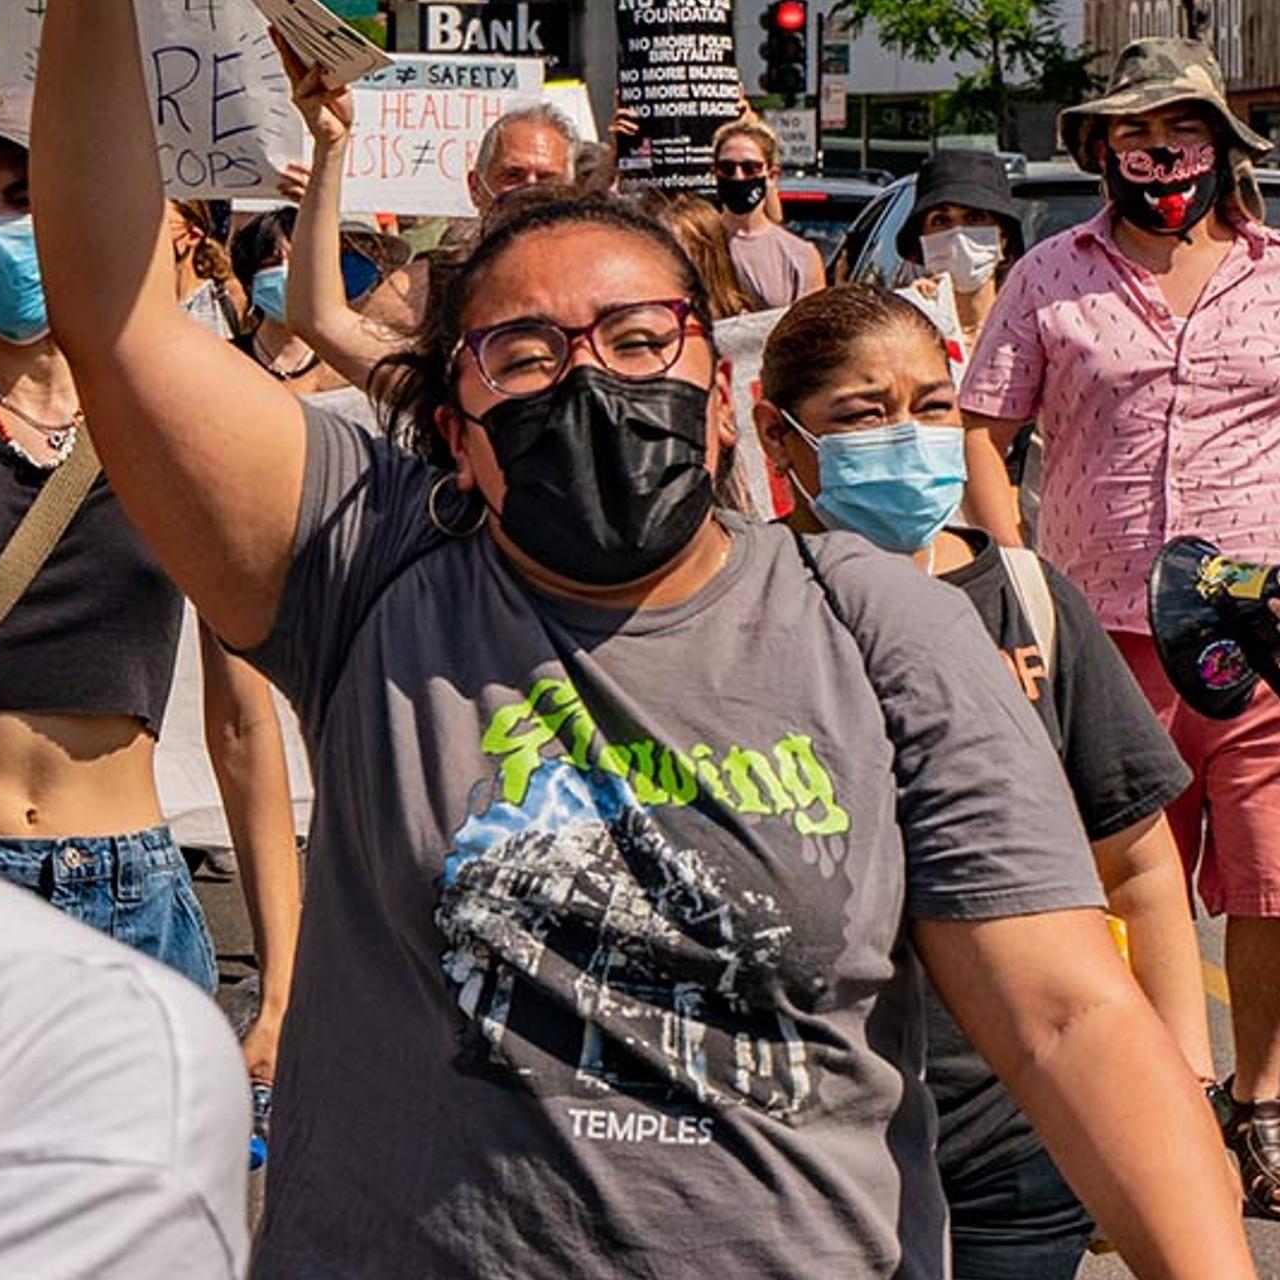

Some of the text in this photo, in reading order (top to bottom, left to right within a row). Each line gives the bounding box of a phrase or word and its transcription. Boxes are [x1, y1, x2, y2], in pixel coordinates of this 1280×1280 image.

[153, 45, 258, 144] RE
[428, 66, 514, 88] SAFETY
[381, 93, 502, 131] HEALTH
[568, 1107, 714, 1146] TEMPLES
